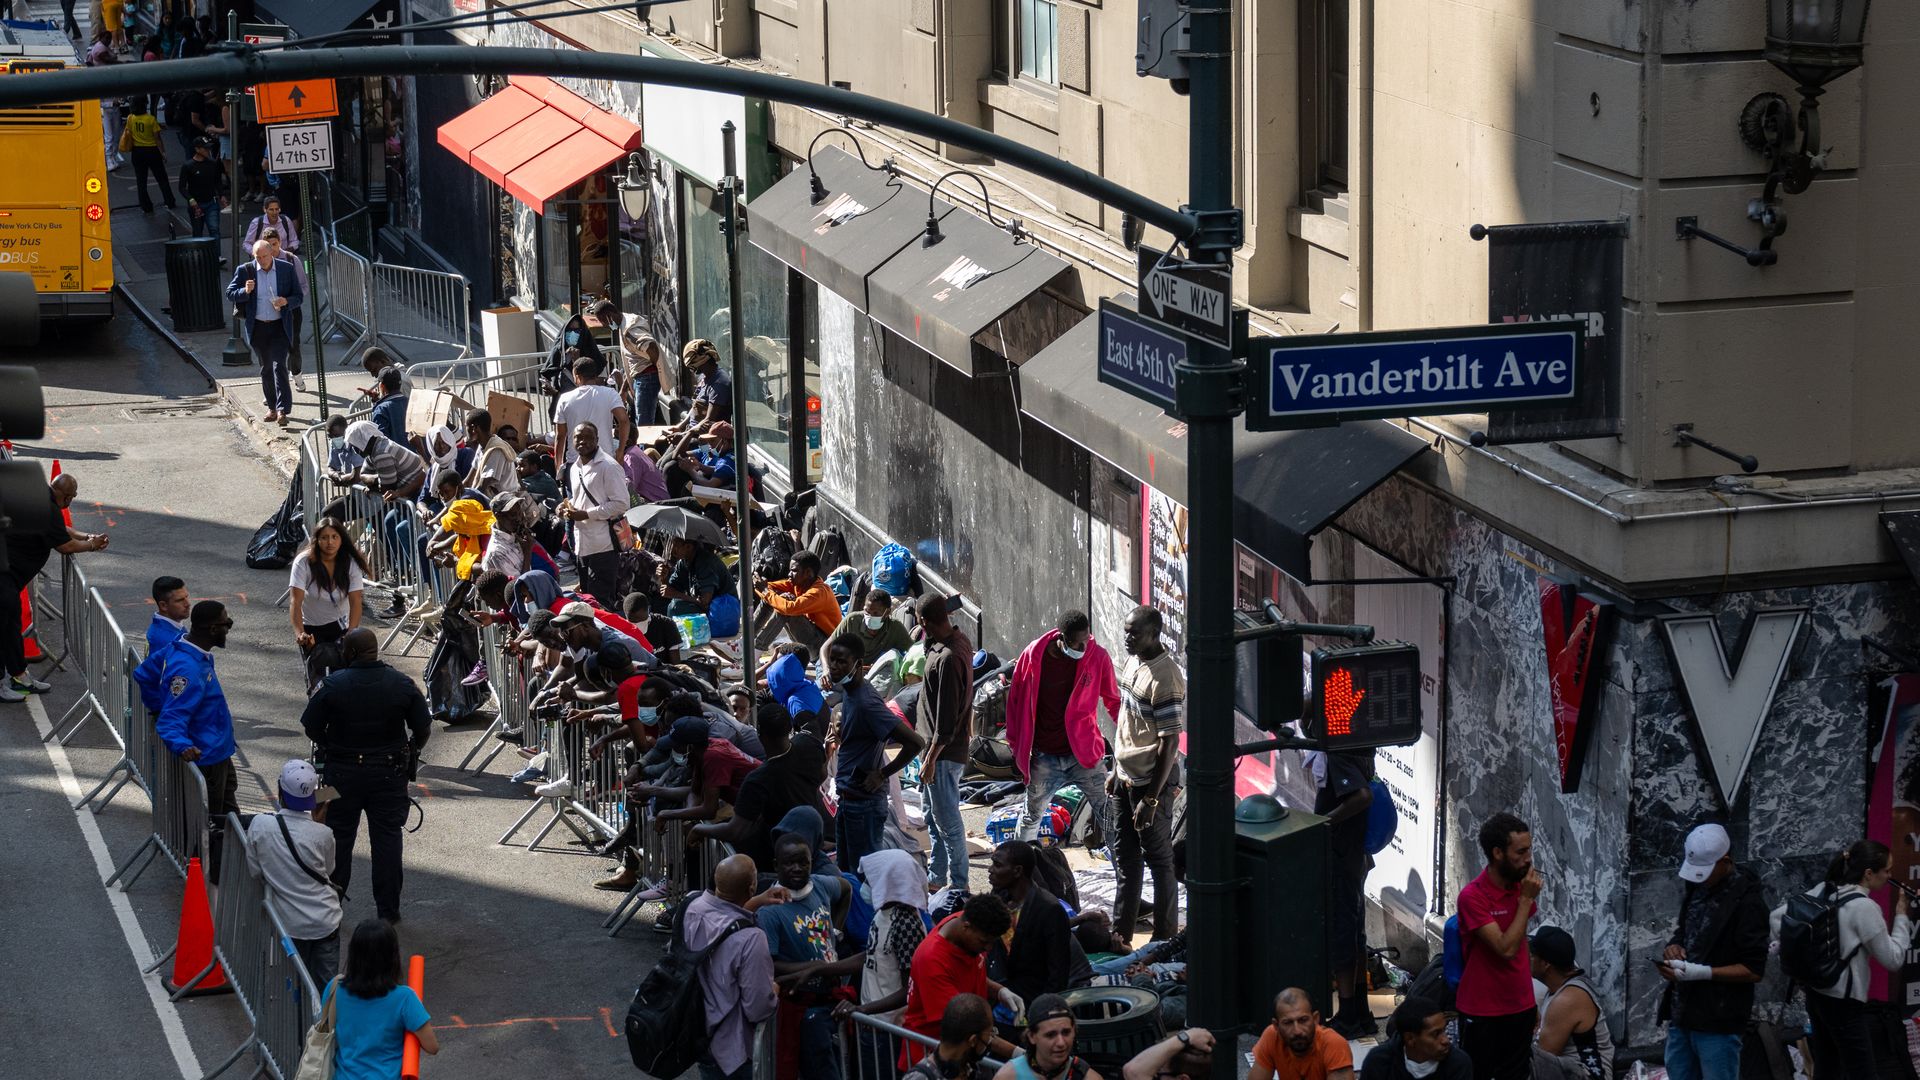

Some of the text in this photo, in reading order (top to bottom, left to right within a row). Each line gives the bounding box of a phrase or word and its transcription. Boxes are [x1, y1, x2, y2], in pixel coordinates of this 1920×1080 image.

[283, 132, 317, 146] EAST
[276, 148, 327, 164] 47th ST
[20, 236, 40, 246] bus
[1152, 273, 1218, 320] ONE WAY
[1106, 327, 1176, 388] East 45th S
[1279, 351, 1567, 400] Vanderbilt Ave
[1171, 615, 1182, 634] the
[1419, 672, 1436, 696] KET
[1402, 792, 1407, 802] to
